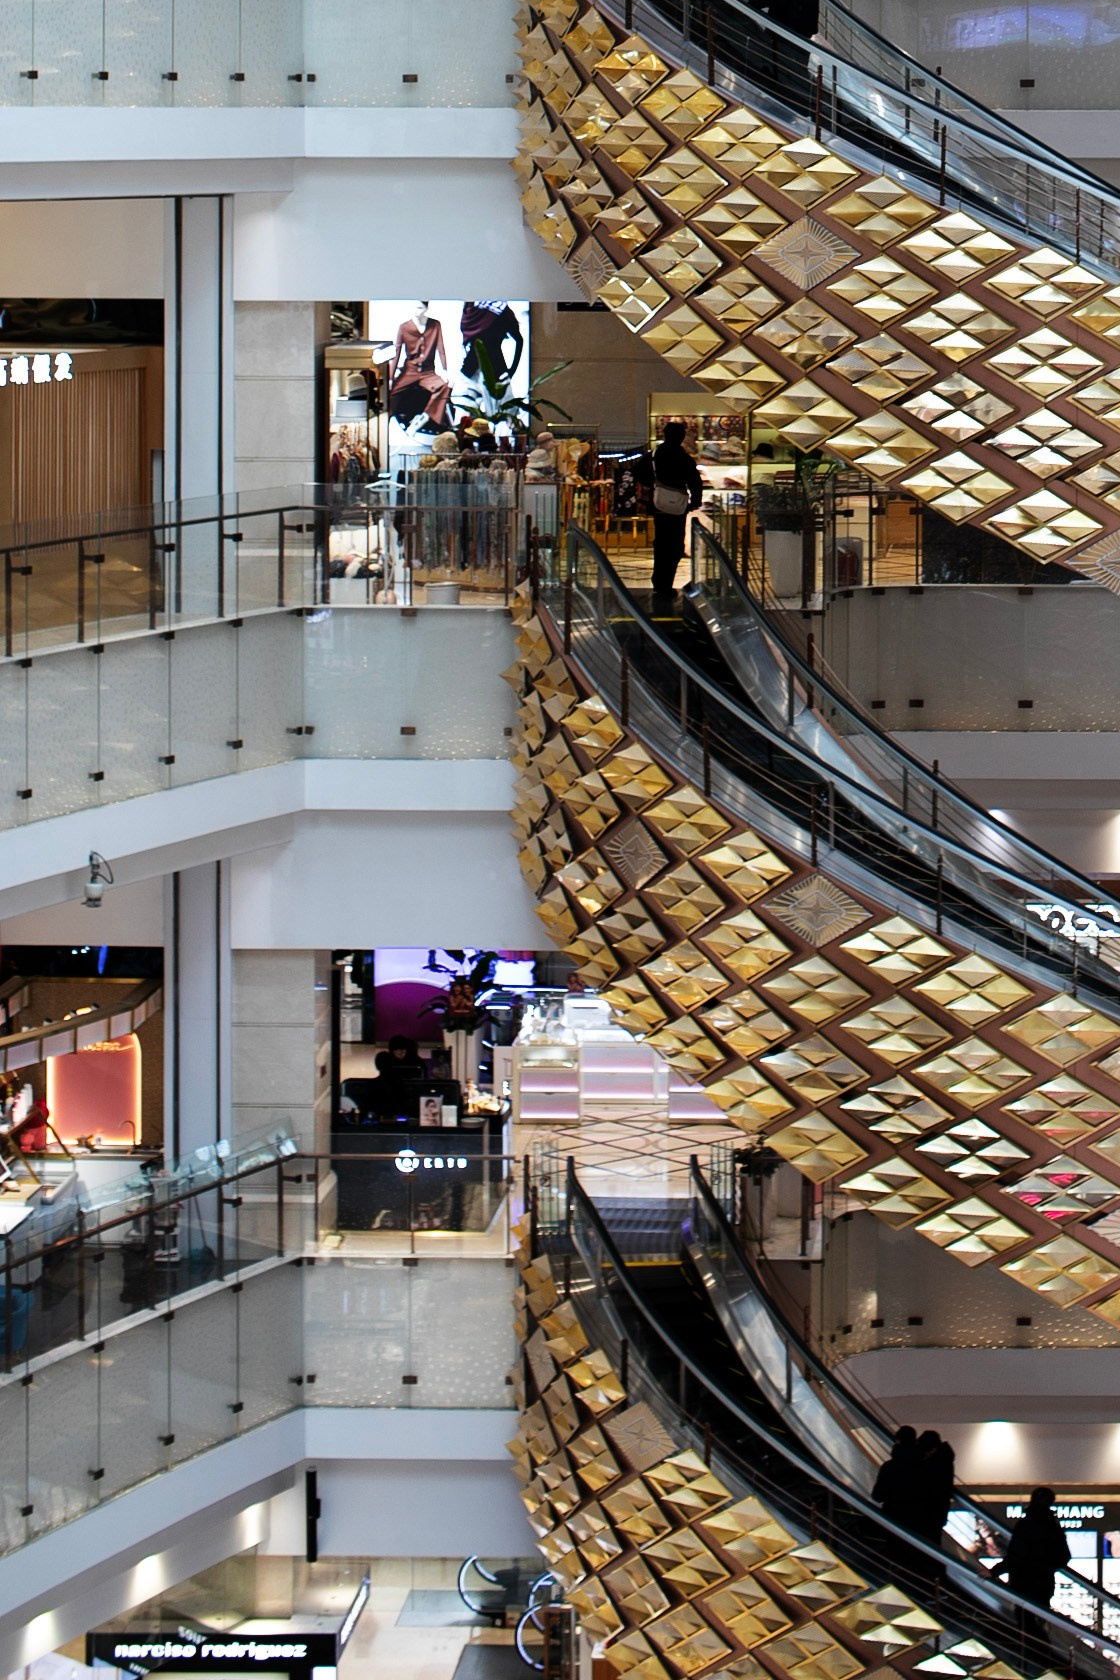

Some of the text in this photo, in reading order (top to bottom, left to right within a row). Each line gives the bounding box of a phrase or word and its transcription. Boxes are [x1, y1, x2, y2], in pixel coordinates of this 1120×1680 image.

[1006, 1505, 1105, 1519] MHANG
[114, 1641, 308, 1661] narciso rodriguez
